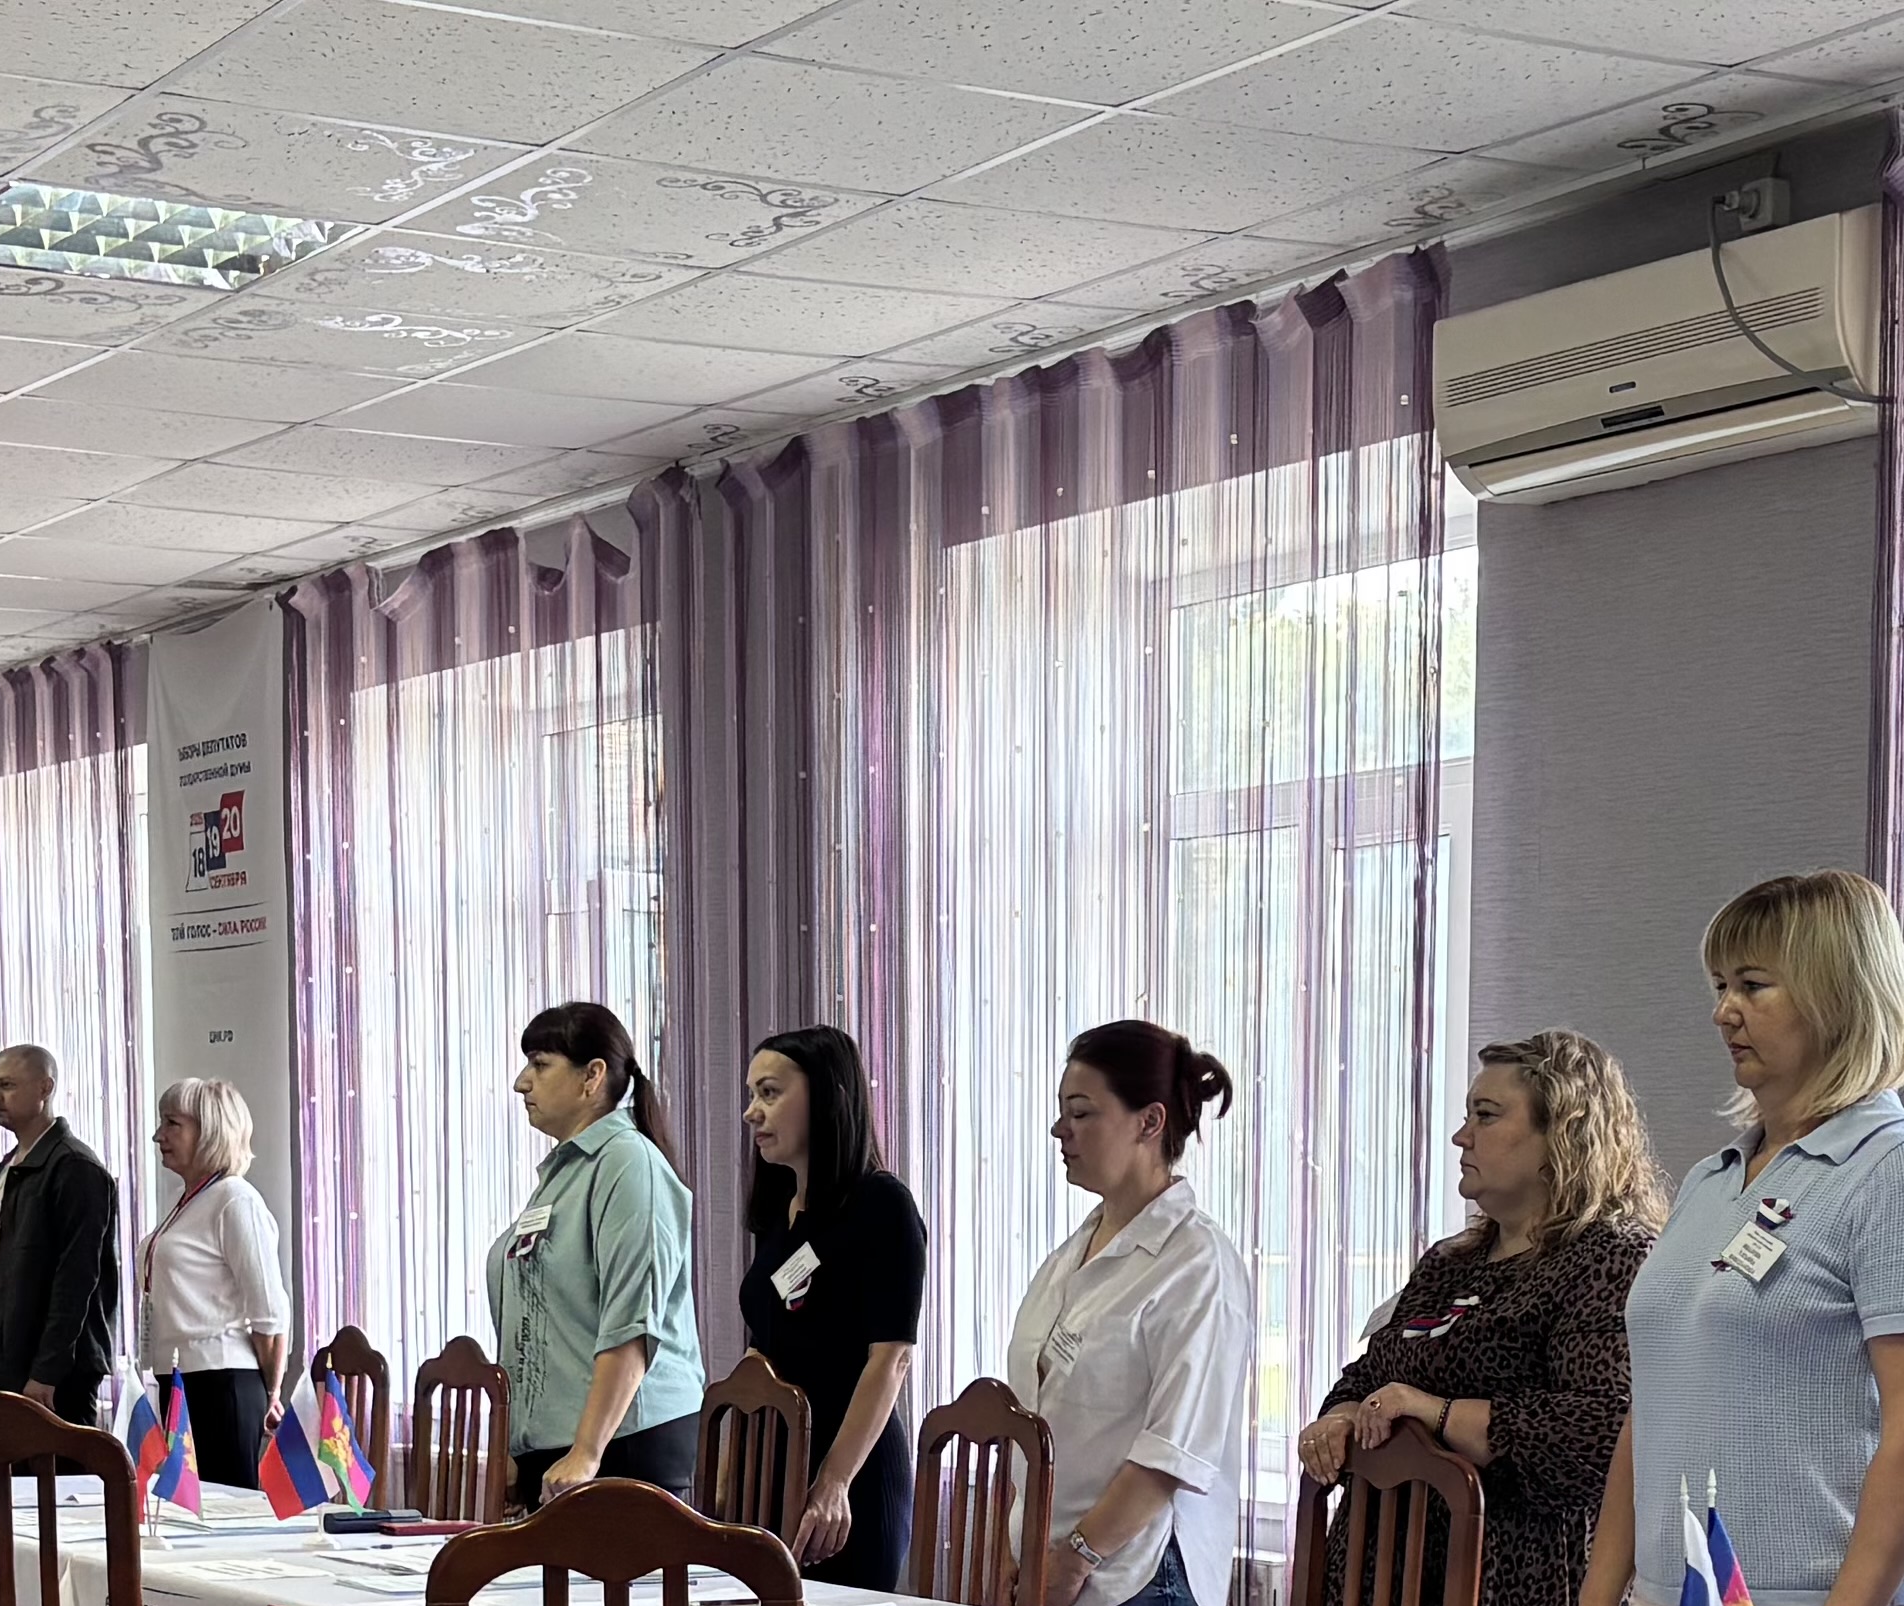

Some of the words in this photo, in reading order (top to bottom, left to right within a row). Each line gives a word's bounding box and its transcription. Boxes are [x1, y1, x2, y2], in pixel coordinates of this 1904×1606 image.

[193, 847, 206, 878] 18
[207, 825, 220, 859] 19
[221, 805, 240, 840] 20
